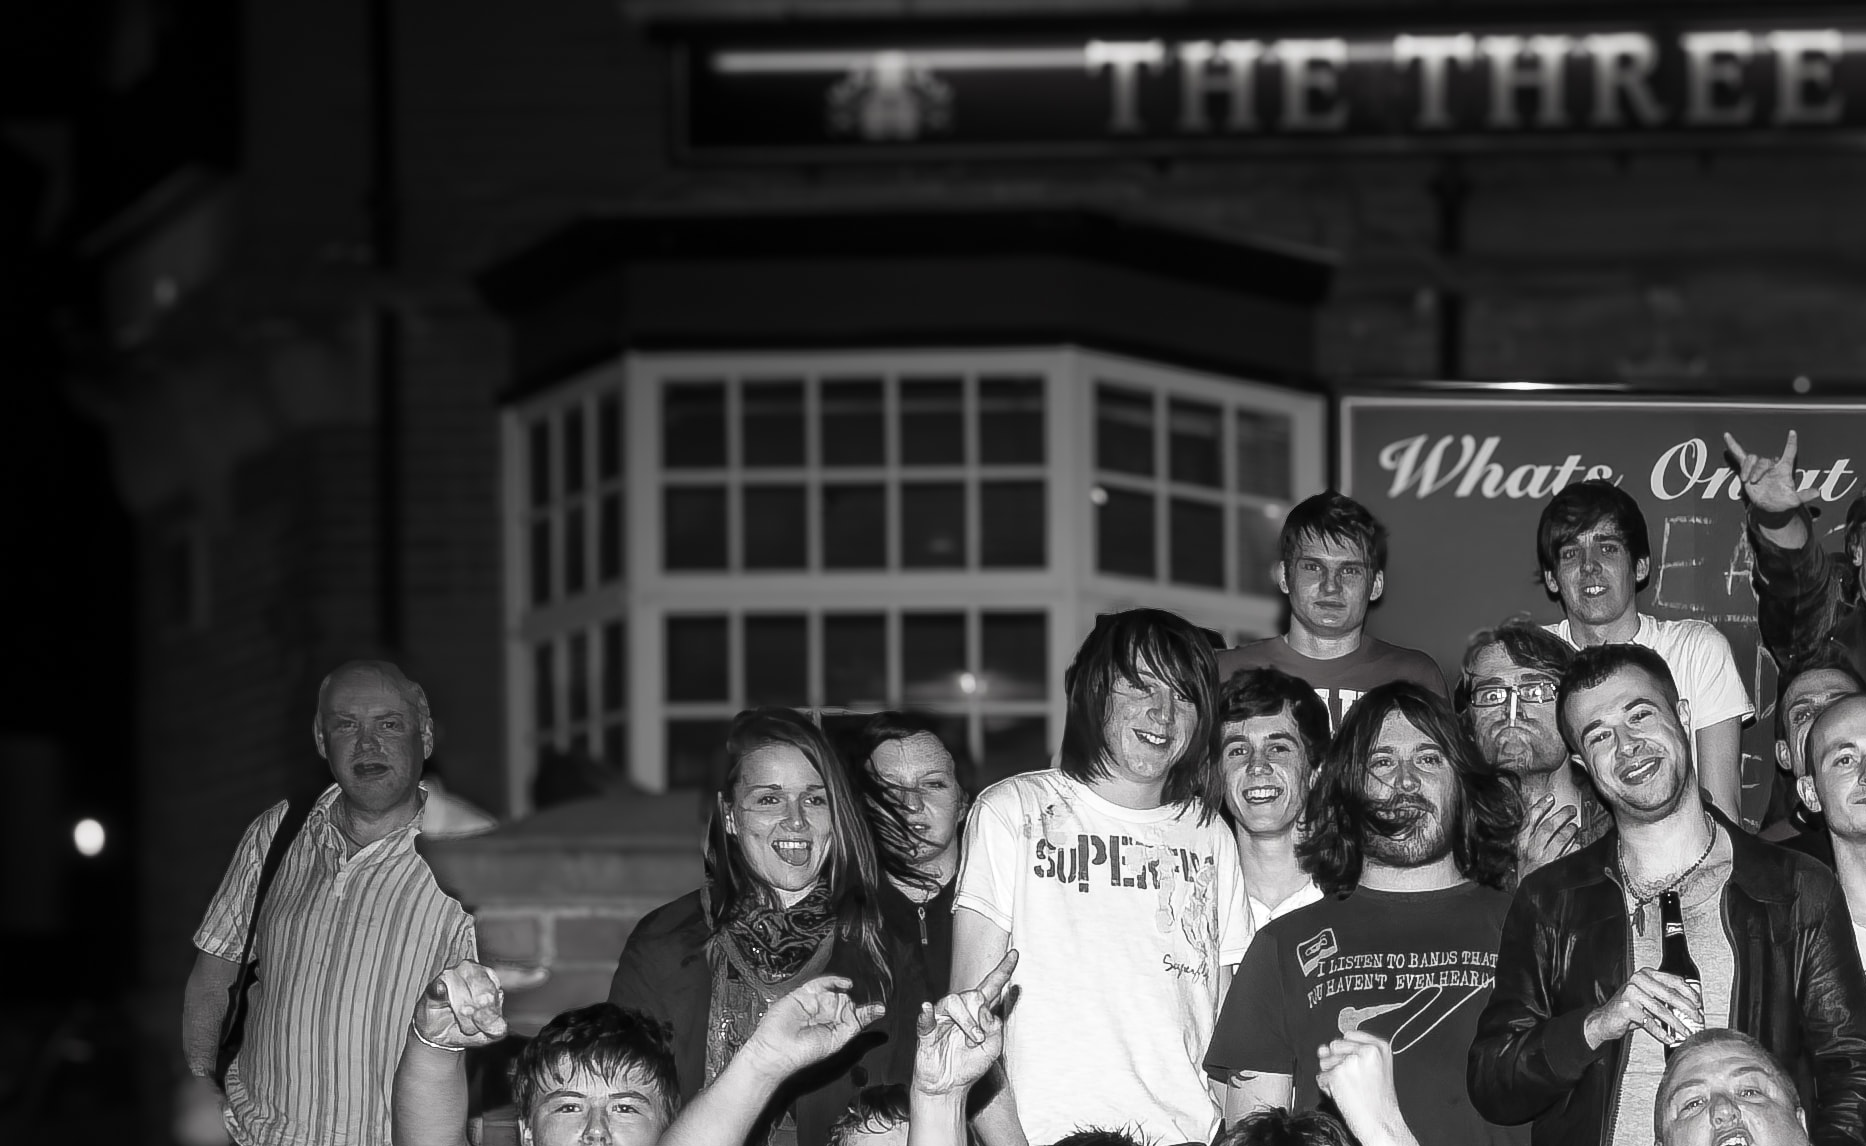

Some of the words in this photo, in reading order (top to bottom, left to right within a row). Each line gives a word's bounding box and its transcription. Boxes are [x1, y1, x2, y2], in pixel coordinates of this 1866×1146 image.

[1083, 38, 1350, 131] THE
[1392, 32, 1843, 129] THREE
[1328, 953, 1383, 974] LISTEN
[1386, 953, 1405, 969] TO
[1407, 951, 1458, 969] BANDS
[1461, 951, 1499, 969] THAT
[1325, 973, 1388, 998] HAVEN'T
[1394, 972, 1436, 991] EVEN
